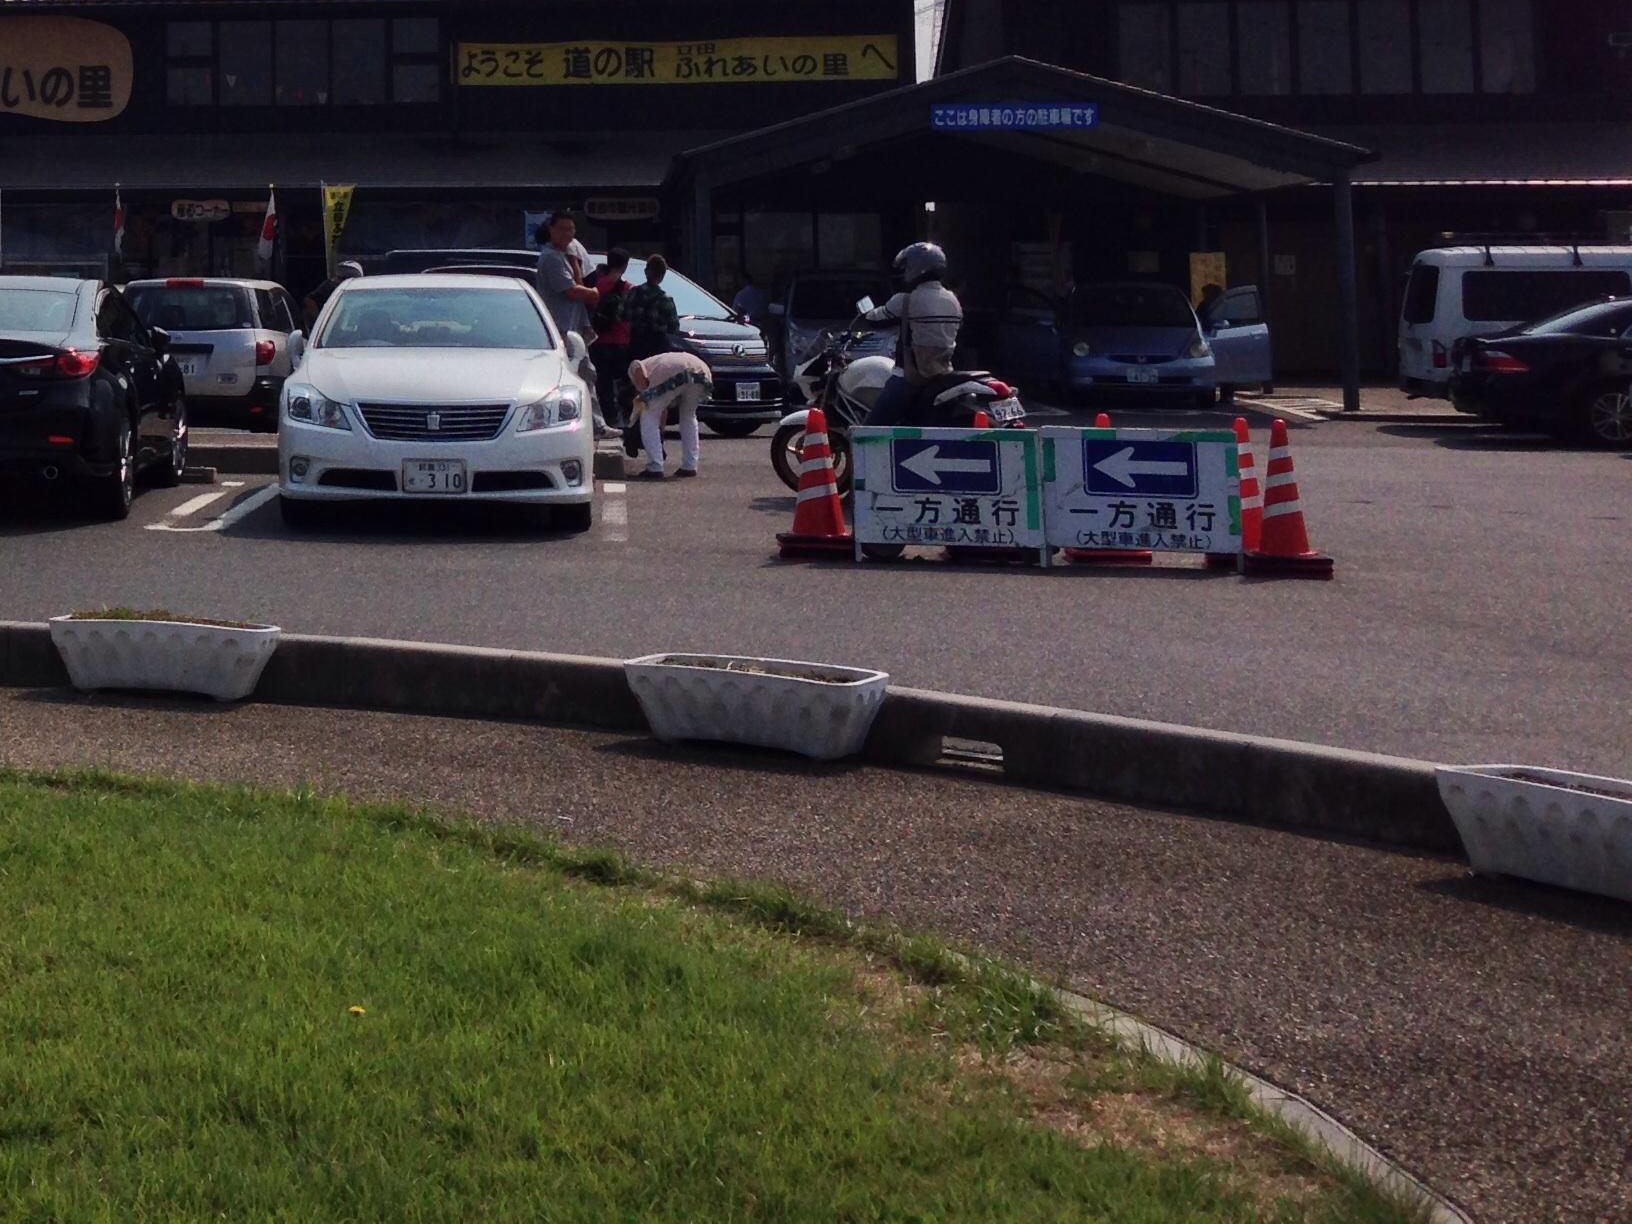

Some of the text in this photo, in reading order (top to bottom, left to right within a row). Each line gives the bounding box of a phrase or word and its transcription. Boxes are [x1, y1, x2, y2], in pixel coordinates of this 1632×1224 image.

[462, 43, 895, 79] ようこそ 道の駅 ふれあいの里 へ
[876, 497, 1020, 527] 一方通行
[1069, 501, 1216, 532] 一方通行
